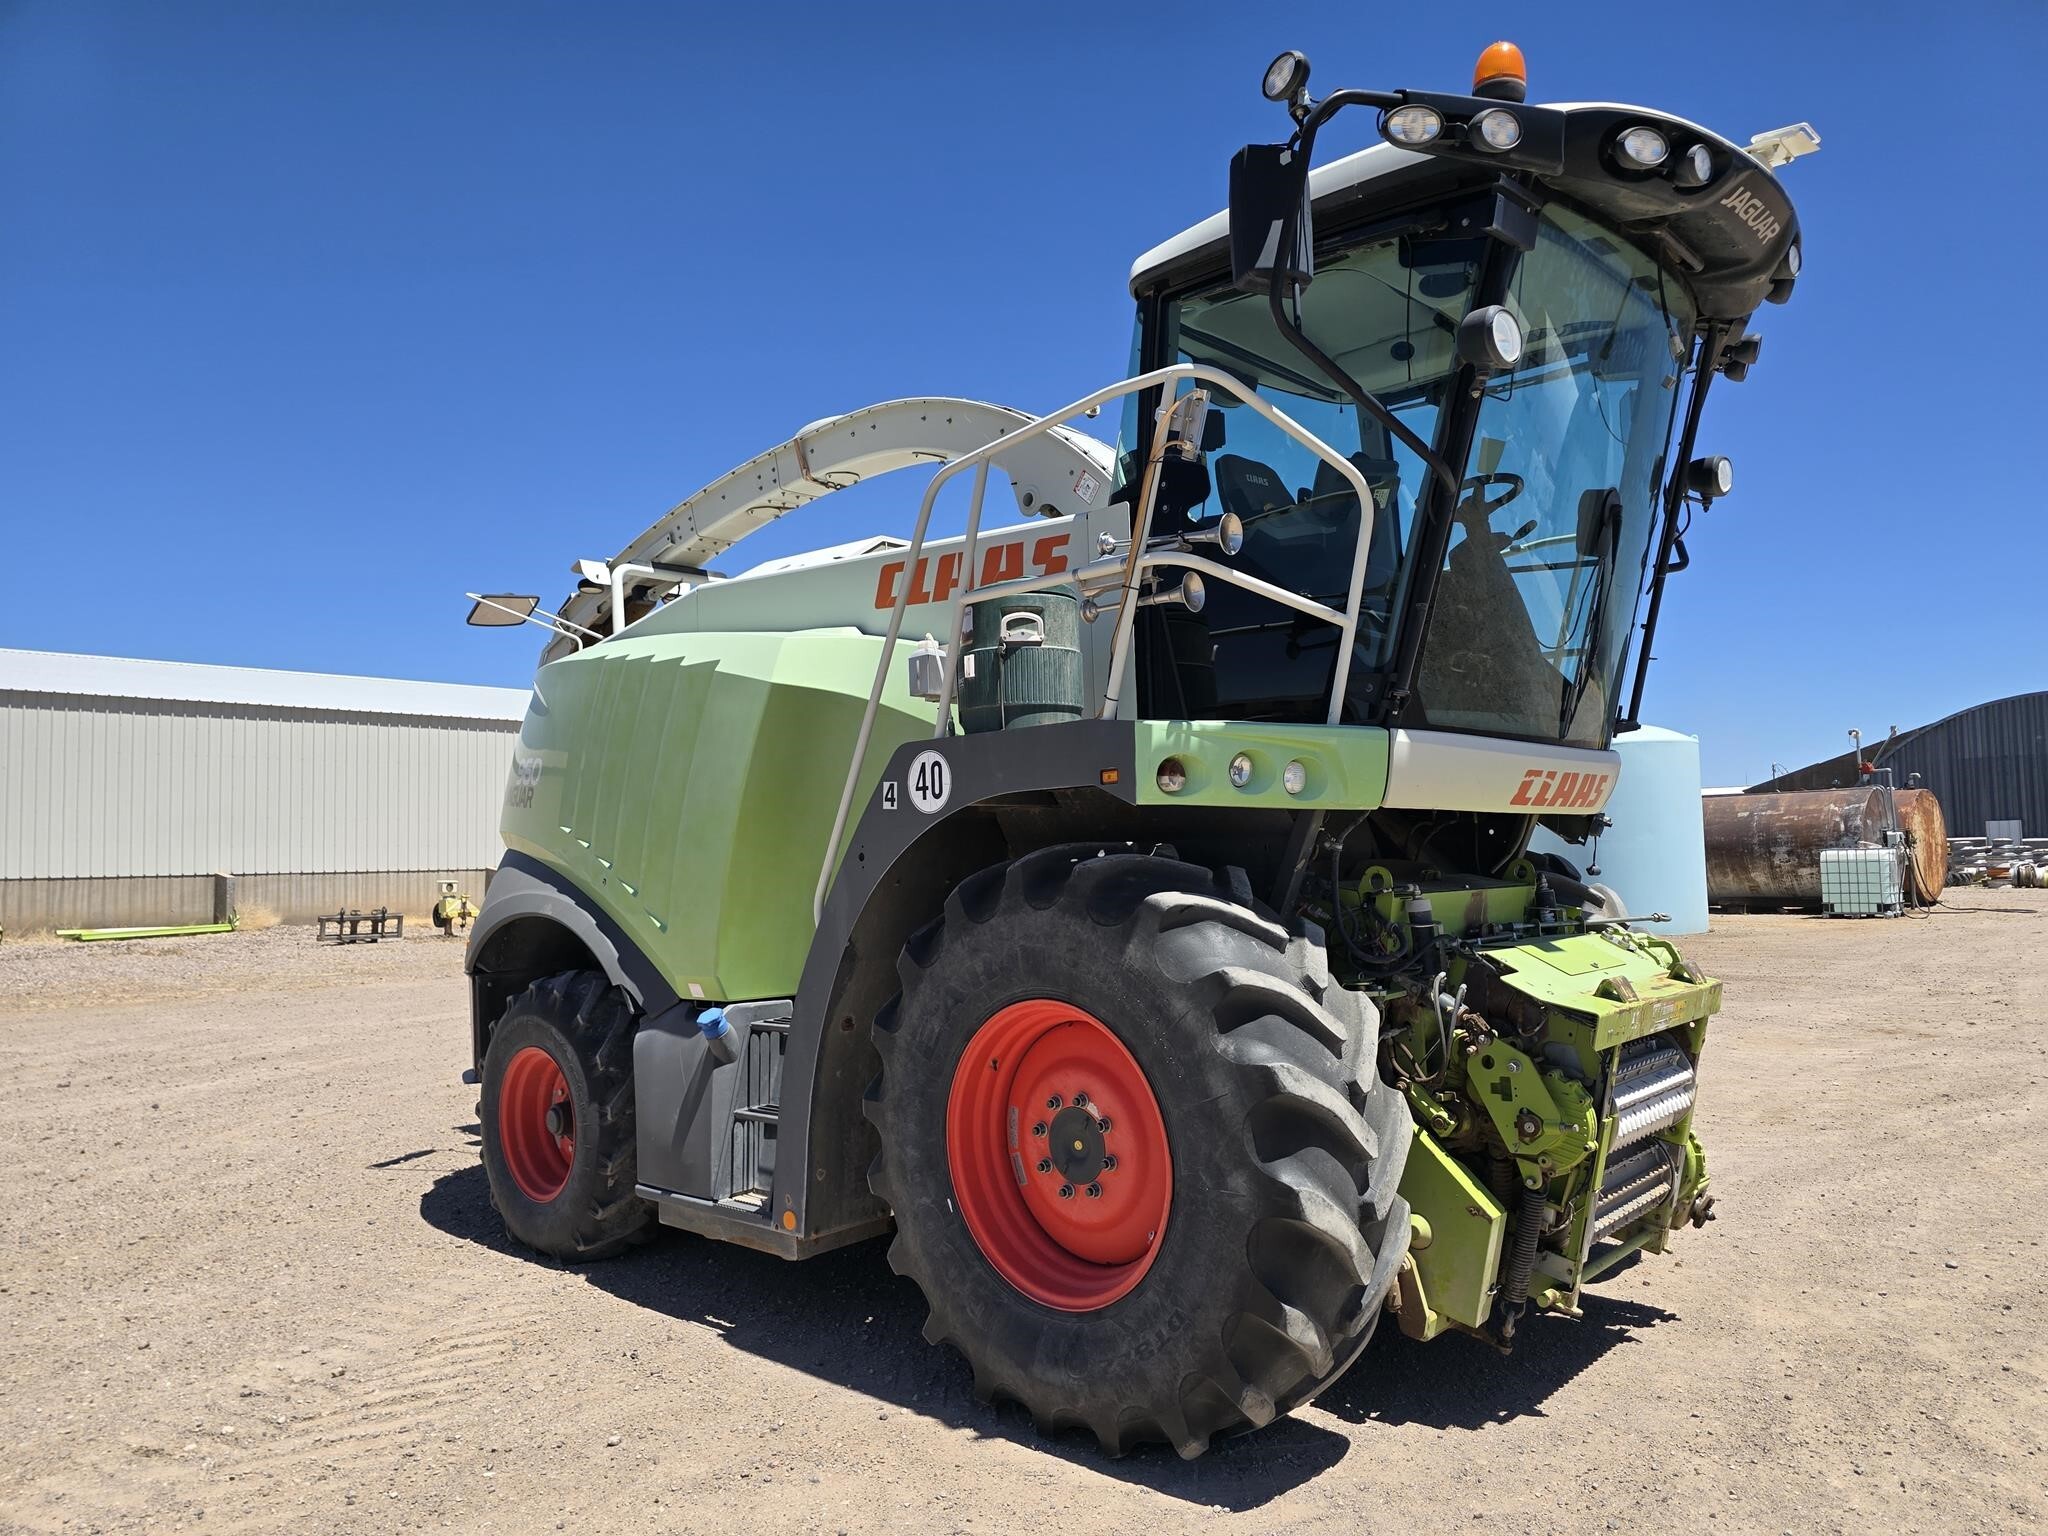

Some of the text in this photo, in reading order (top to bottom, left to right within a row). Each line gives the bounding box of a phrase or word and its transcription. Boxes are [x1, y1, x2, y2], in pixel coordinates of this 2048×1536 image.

[1720, 186, 1781, 245] JAGUAR
[874, 533, 1071, 610] CLAAS
[884, 783, 897, 808] 4
[915, 760, 944, 801] 40
[1509, 769, 1609, 808] CLAAS
